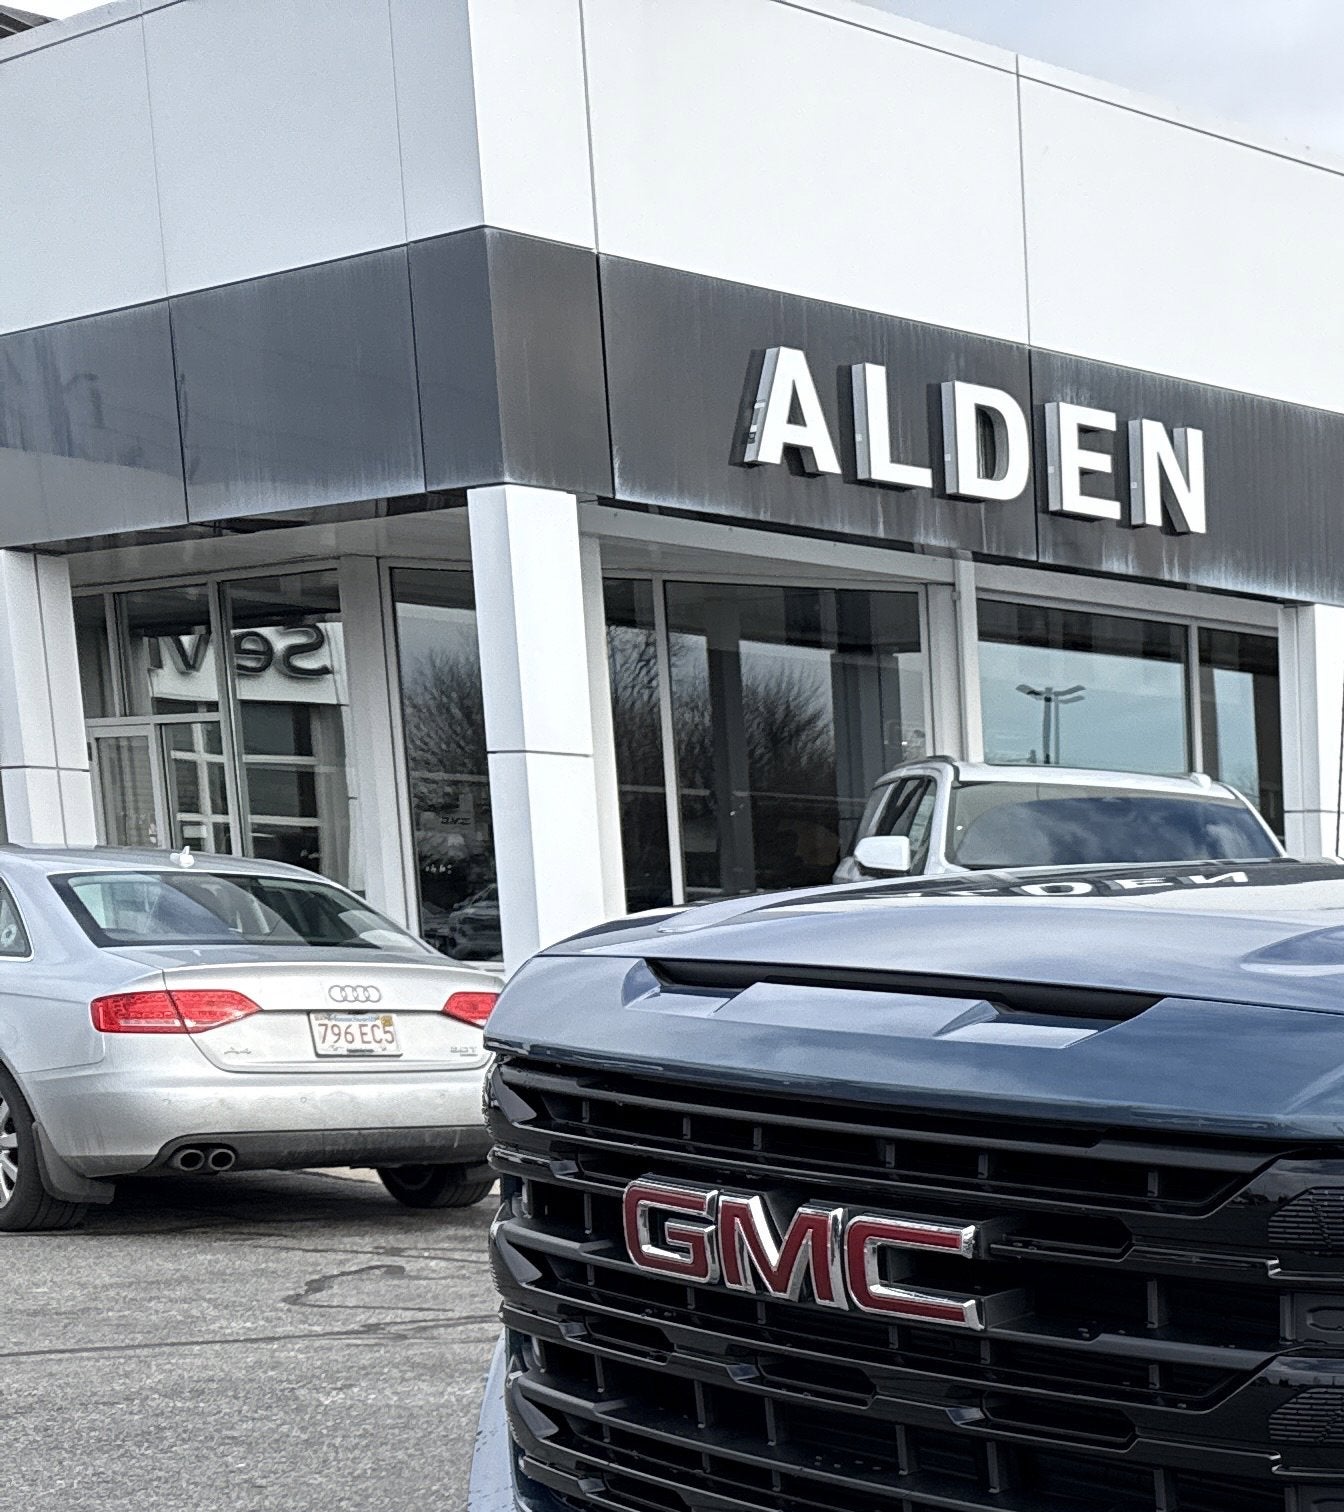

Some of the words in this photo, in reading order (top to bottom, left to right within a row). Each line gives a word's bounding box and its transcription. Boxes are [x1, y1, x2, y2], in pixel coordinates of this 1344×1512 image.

[745, 345, 1206, 534] ALDEN
[318, 1023, 355, 1044] 796
[358, 1023, 395, 1044] EC5
[622, 1174, 985, 1331] GMC
